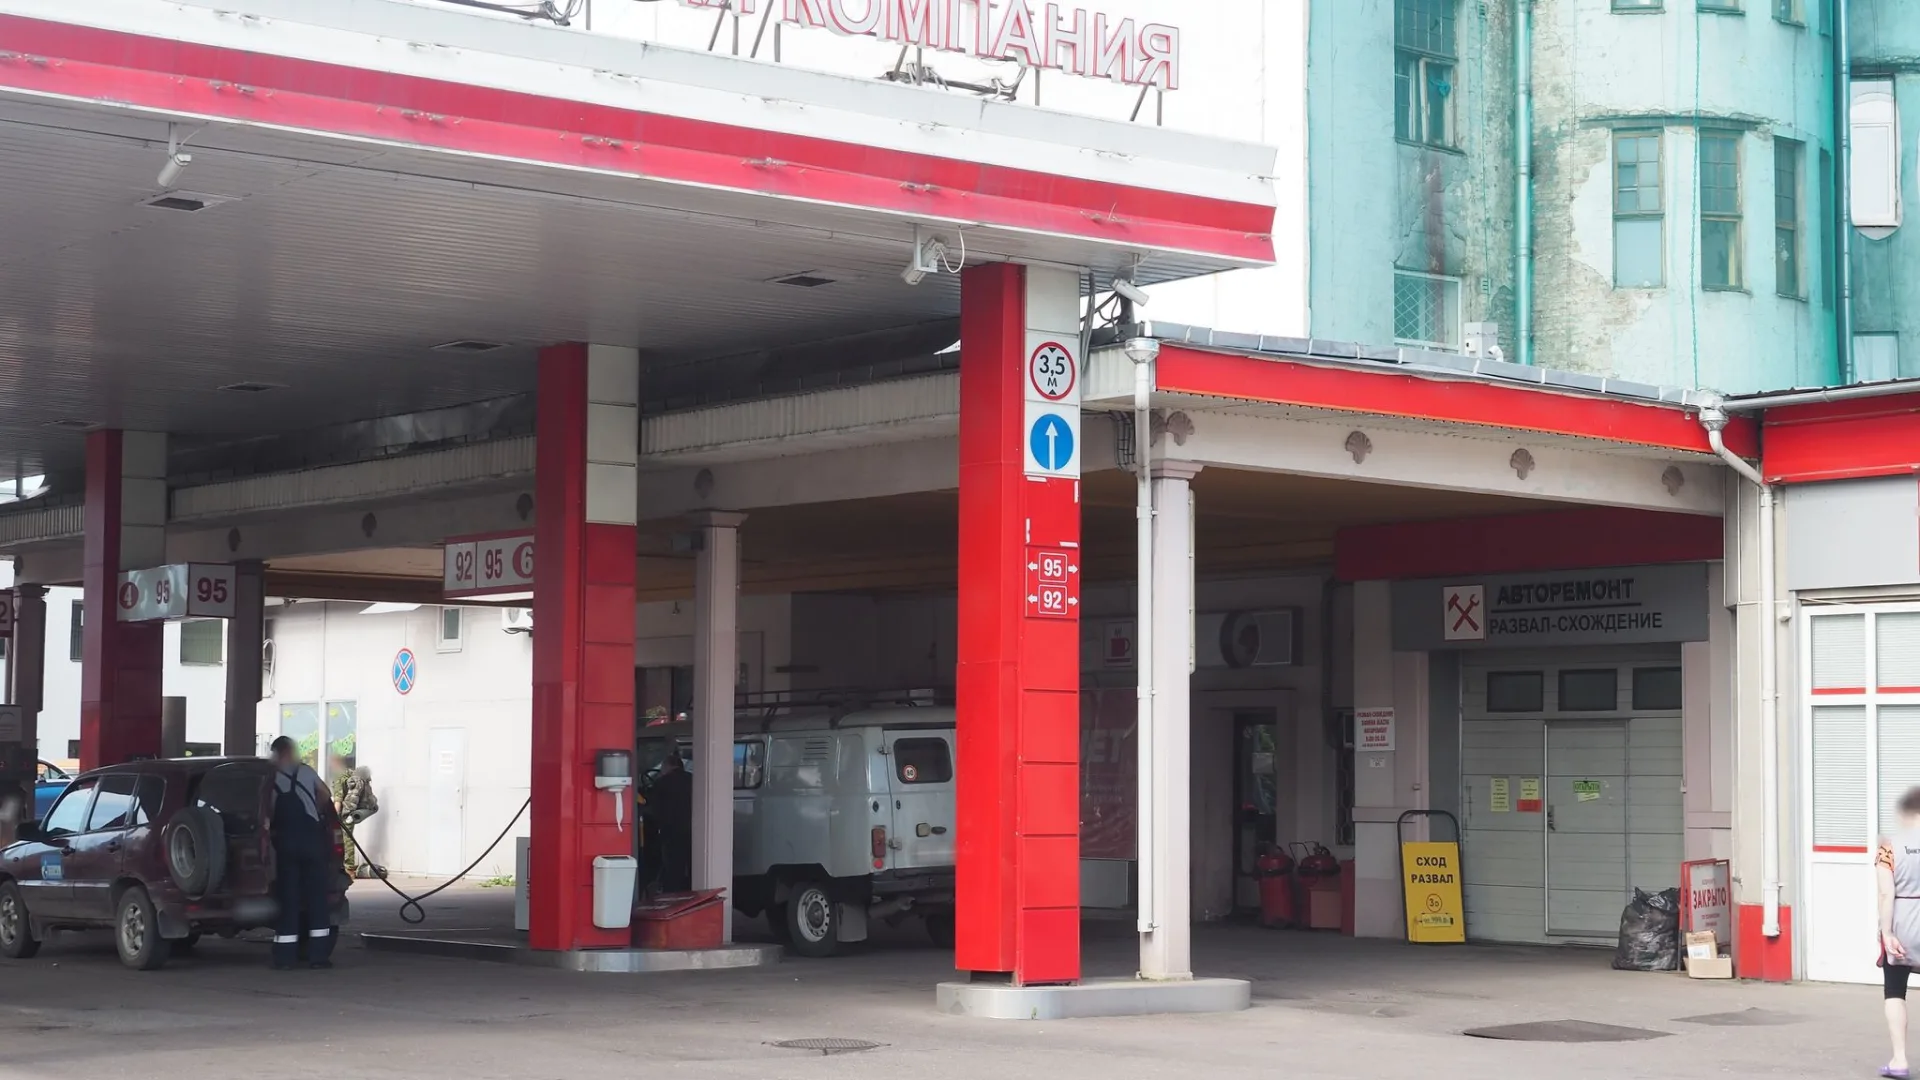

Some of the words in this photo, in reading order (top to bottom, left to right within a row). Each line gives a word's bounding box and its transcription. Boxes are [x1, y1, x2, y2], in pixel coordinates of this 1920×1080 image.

[1039, 355, 1066, 376] 3,5
[1047, 377, 1058, 388] М
[455, 551, 473, 582] 92
[485, 548, 503, 580] 95
[1043, 558, 1062, 578] 95
[155, 579, 171, 605] 95
[197, 576, 228, 604] 95
[1043, 590, 1062, 609] 92
[1496, 578, 1635, 605] АВТОРЕМОНТ
[1489, 612, 1663, 635] РАЗВАЛ-СХОЖДЕНИЕ
[1416, 856, 1447, 868] СХОД
[1411, 874, 1453, 884] РАЗВАЛ
[1693, 887, 1726, 909] ЗАКРЫТО
